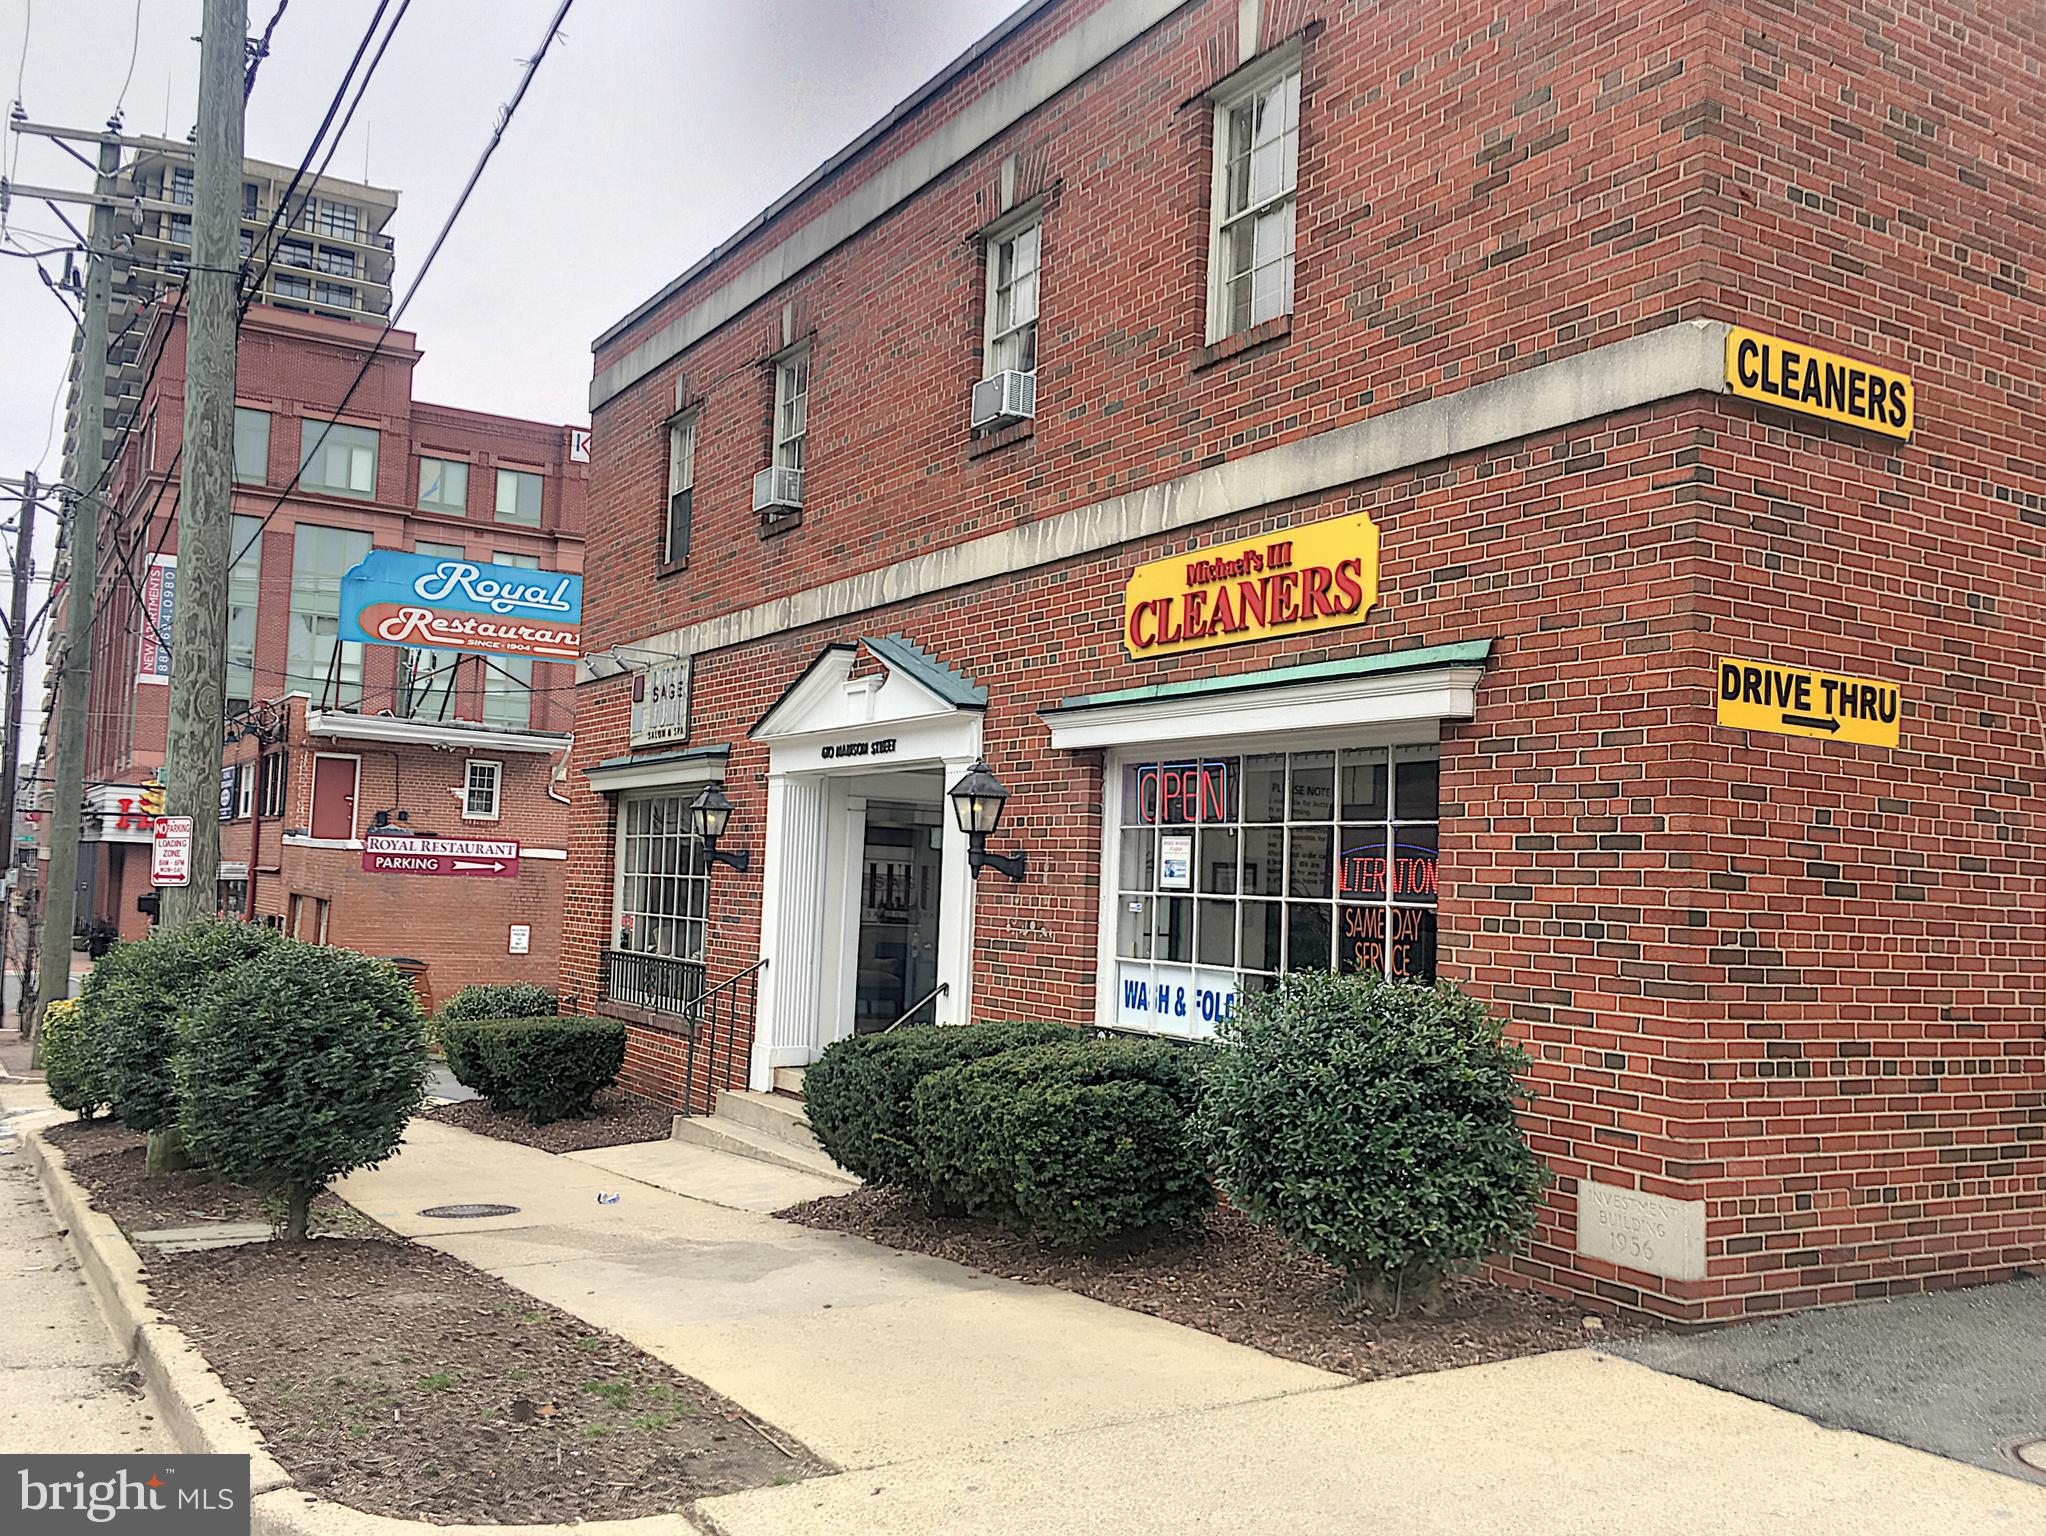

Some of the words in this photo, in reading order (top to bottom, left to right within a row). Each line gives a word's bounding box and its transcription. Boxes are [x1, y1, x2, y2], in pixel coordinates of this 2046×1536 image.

[1738, 338, 1907, 428] CLEANERS
[1186, 549, 1265, 587] Michael's
[1267, 541, 1293, 569] III
[414, 561, 571, 613] Royal
[1129, 558, 1363, 649] CLEANERS
[143, 644, 154, 671] NEW
[466, 638, 501, 649] SINCE
[507, 643, 531, 652] 1904
[653, 681, 683, 703] SAGE
[1721, 664, 1812, 712] DRIVE
[1820, 679, 1897, 724] THRU
[870, 739, 897, 755] STREET
[1140, 769, 1224, 822] OPEN
[1272, 783, 1305, 795] PLSE
[156, 823, 167, 834] NO
[167, 824, 190, 832] PARKING
[369, 838, 417, 852] ROYAL
[420, 840, 516, 856] RESTAURANT
[375, 857, 439, 870] PARKING
[1345, 907, 1385, 939] SAME
[1391, 908, 1422, 941] DAY
[1355, 941, 1410, 976] SERVCE
[1124, 979, 1170, 1014] WAH
[1174, 986, 1187, 1017] &
[1588, 1189, 1678, 1220] INVESTMENT
[1599, 1210, 1666, 1239] BUILDING
[1610, 1232, 1655, 1261] 1956
